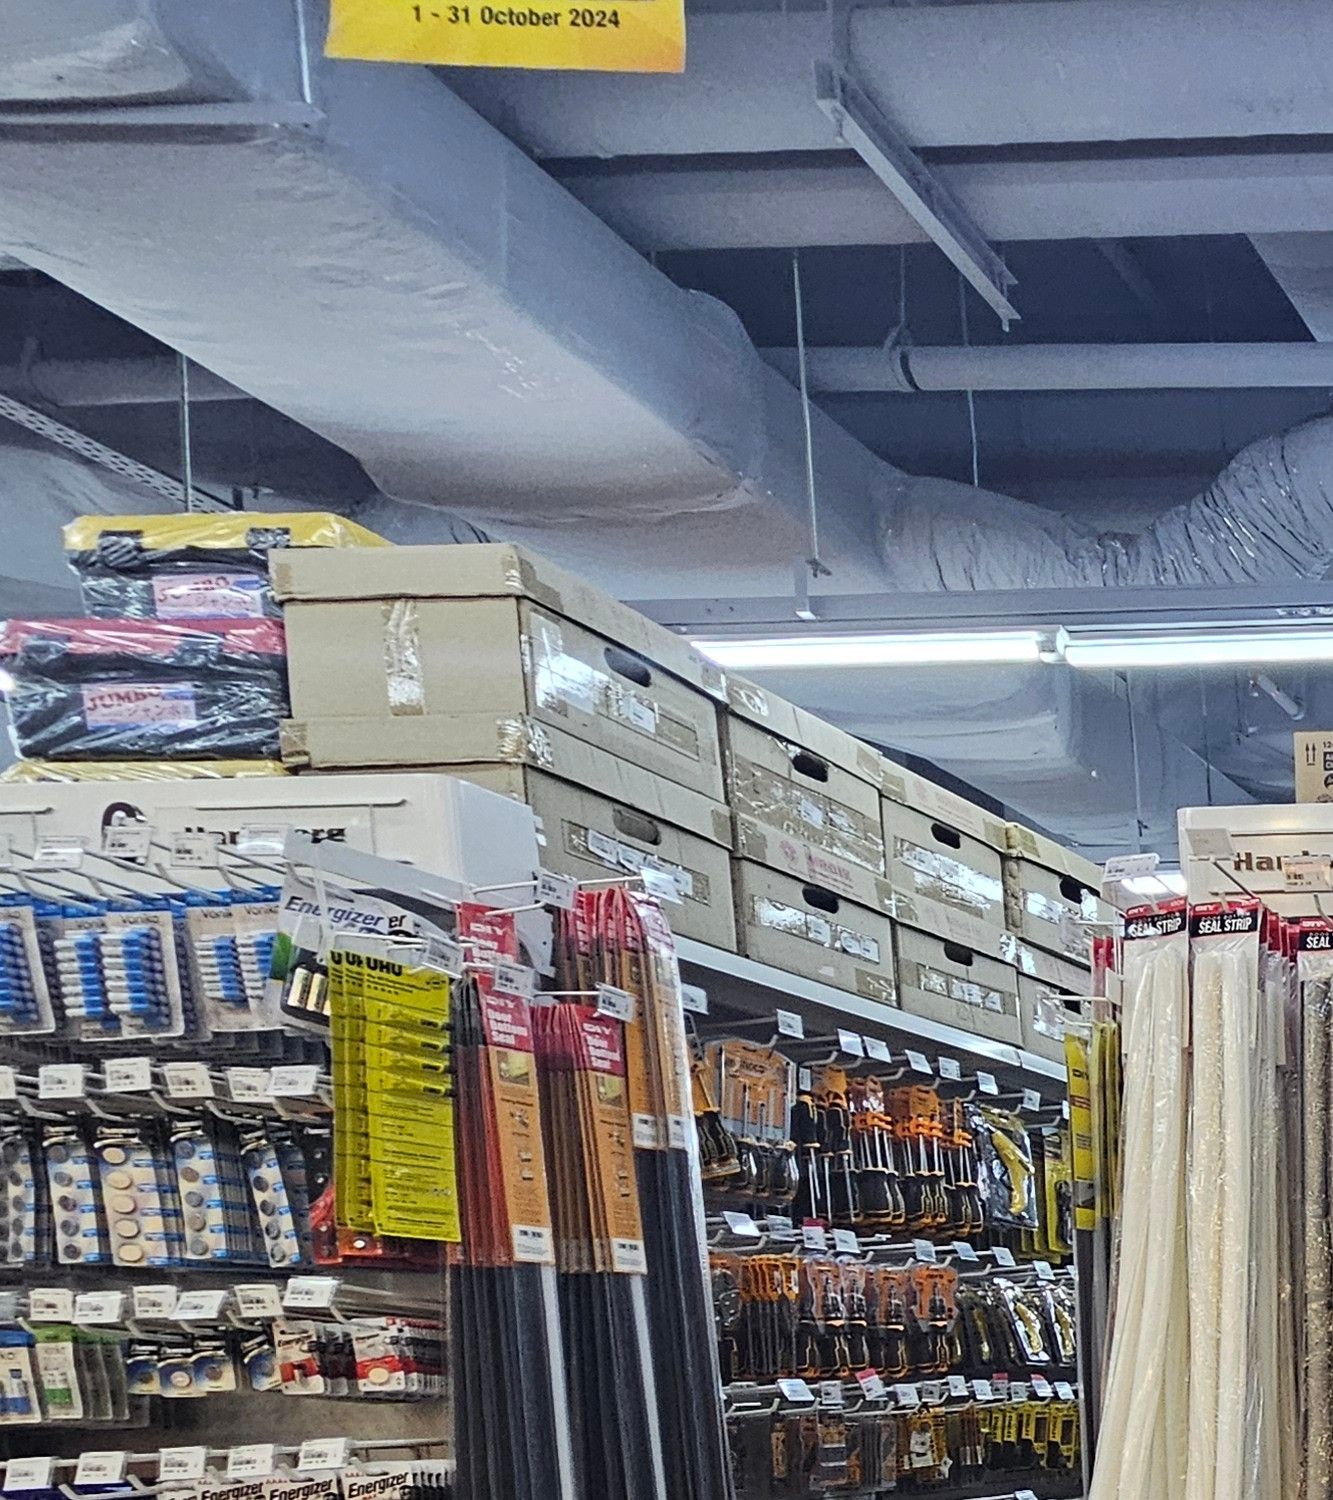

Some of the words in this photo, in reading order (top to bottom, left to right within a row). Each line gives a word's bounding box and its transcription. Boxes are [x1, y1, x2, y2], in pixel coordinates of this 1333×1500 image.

[412, 5, 421, 22] 1
[447, 6, 470, 24] 31
[480, 8, 561, 27] October
[568, 8, 621, 28] 2024
[284, 895, 385, 928] Energizer
[1156, 916, 1182, 934] STRIP
[1198, 919, 1223, 934] SEAL
[1223, 916, 1251, 932] STRIP
[1305, 935, 1332, 950] SEAL
[365, 956, 403, 977] UHU
[347, 1471, 410, 1498] Energizer
